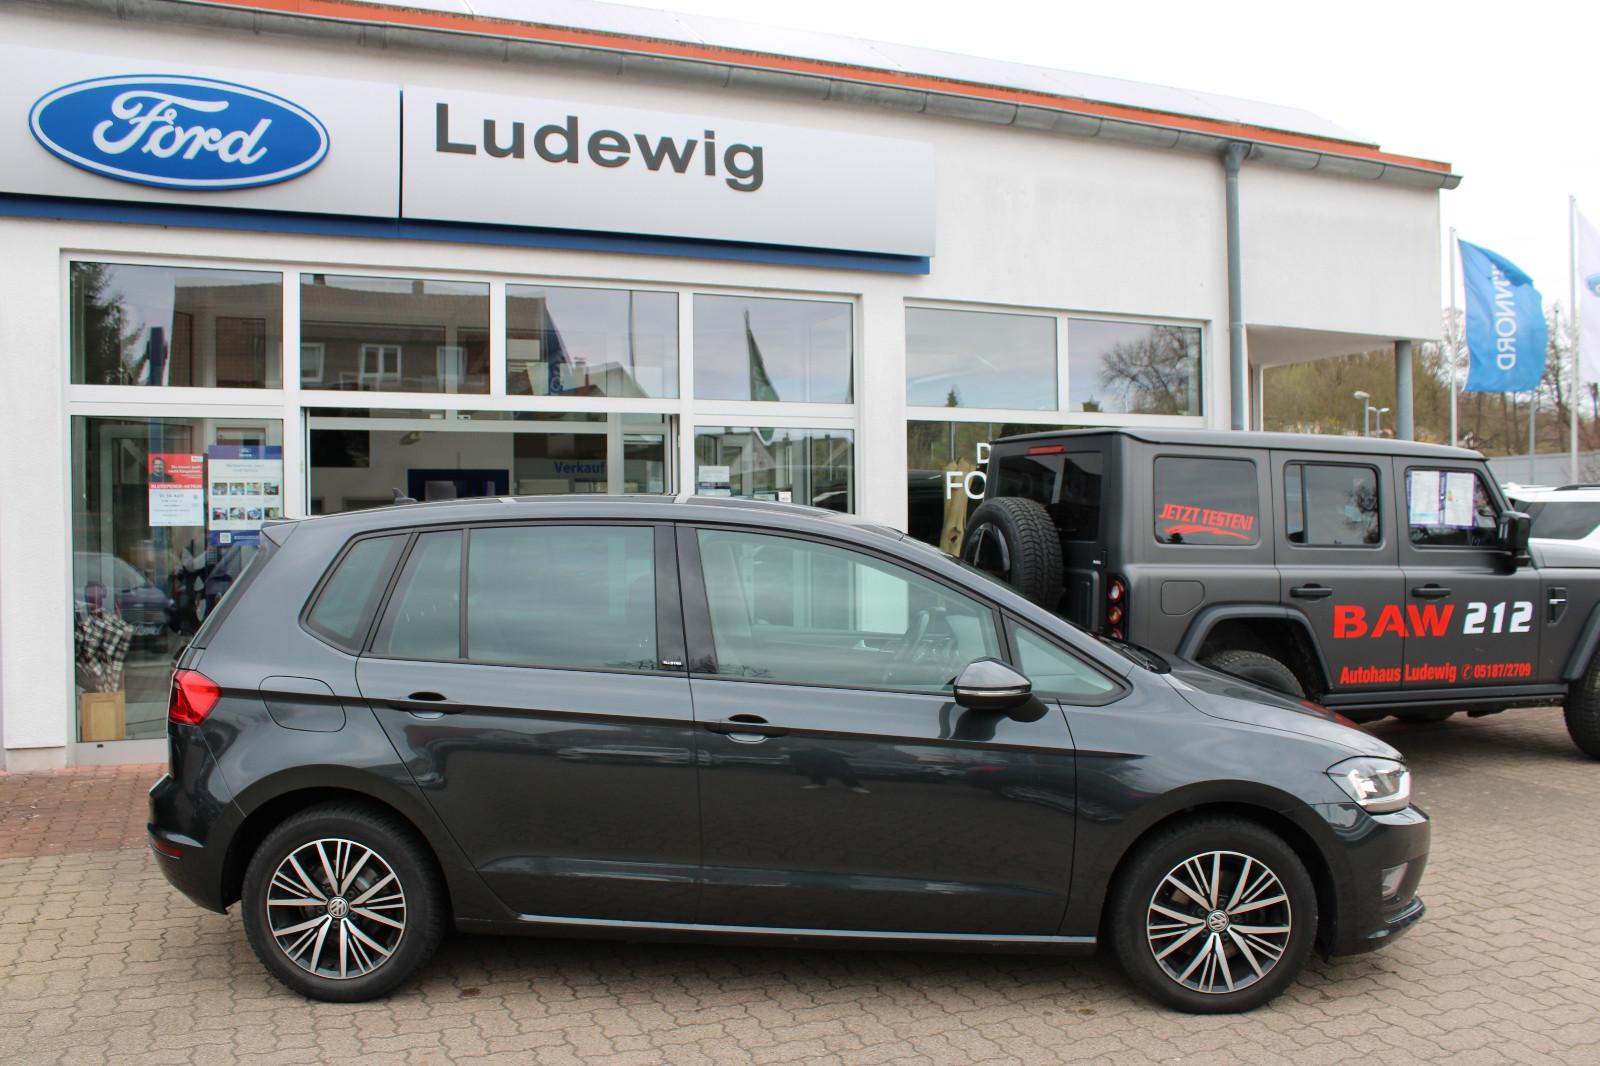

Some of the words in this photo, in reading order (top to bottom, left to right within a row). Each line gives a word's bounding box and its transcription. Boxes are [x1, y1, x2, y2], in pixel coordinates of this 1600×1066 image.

[92, 88, 272, 165] Ford
[435, 102, 764, 193] Ludewig
[554, 461, 605, 474] Verkauf
[1159, 503, 1201, 523] JETZT
[1333, 603, 1455, 639] BAW
[1463, 601, 1533, 635] 212
[1339, 664, 1402, 685] Autohaus
[1404, 662, 1457, 683] Ludewig
[1473, 662, 1531, 679] 05187/2709
